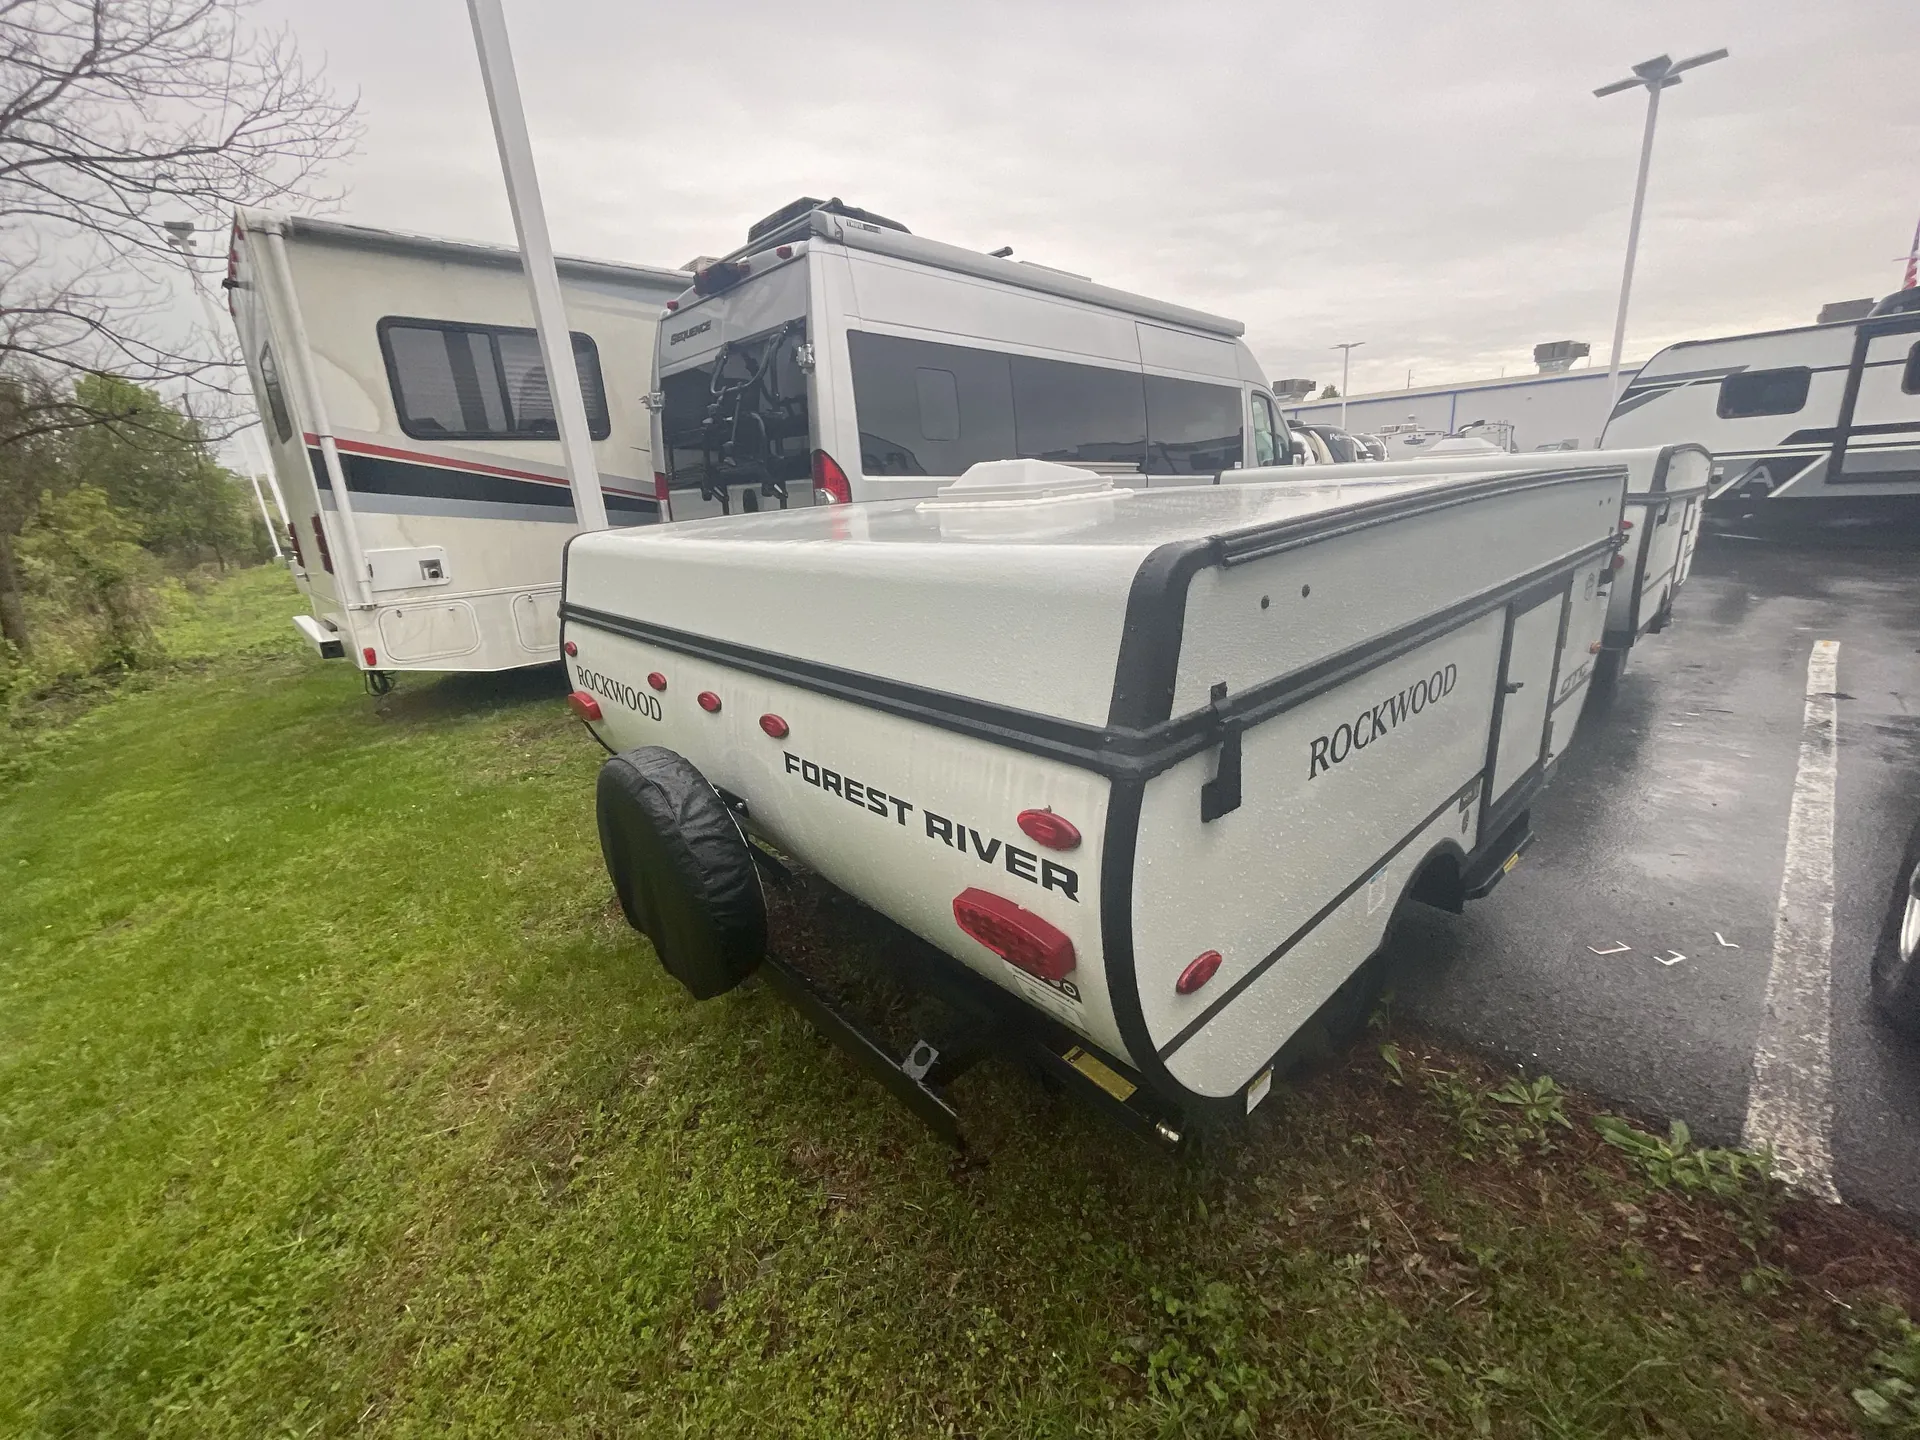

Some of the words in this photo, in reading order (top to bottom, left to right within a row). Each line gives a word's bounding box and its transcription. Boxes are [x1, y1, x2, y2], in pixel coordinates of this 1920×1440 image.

[576, 664, 662, 721] ROCKWOOD
[1308, 663, 1457, 781] ROCKWOOD
[783, 750, 913, 826] FOREST
[923, 809, 1080, 903] RIVER
